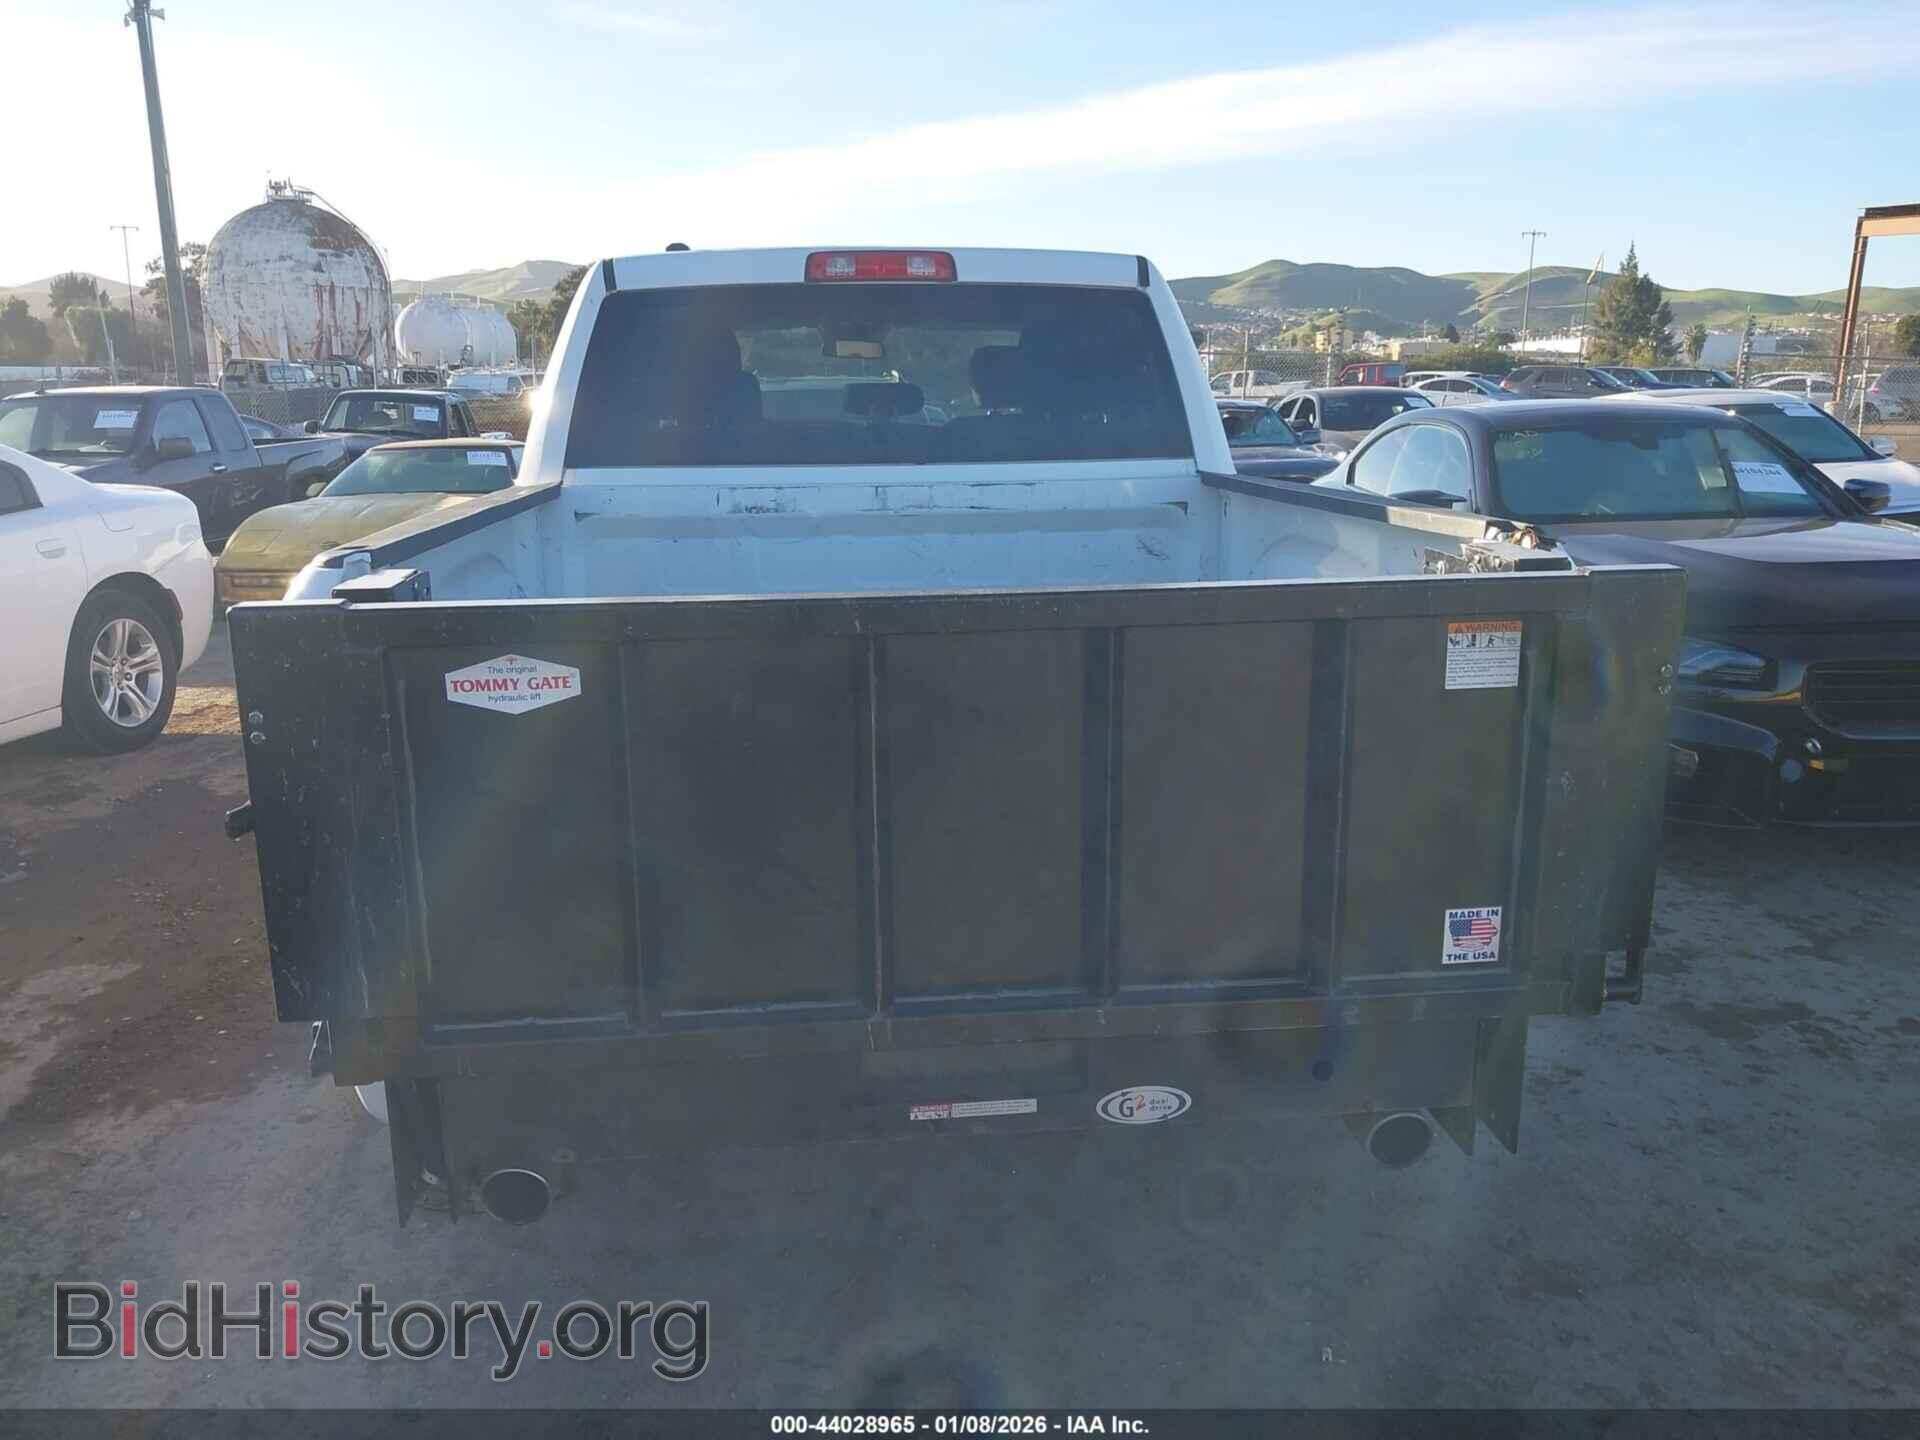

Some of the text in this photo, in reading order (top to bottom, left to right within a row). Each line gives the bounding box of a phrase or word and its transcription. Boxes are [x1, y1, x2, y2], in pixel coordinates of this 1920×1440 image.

[1464, 621, 1520, 633] WARNING
[488, 665, 538, 675] The original
[450, 675, 572, 693] TOMMY GATE
[488, 692, 541, 703] hydraulic lift
[1449, 909, 1499, 919] MADE IN
[1446, 951, 1496, 962] THE USA
[1149, 1096, 1169, 1105] dual
